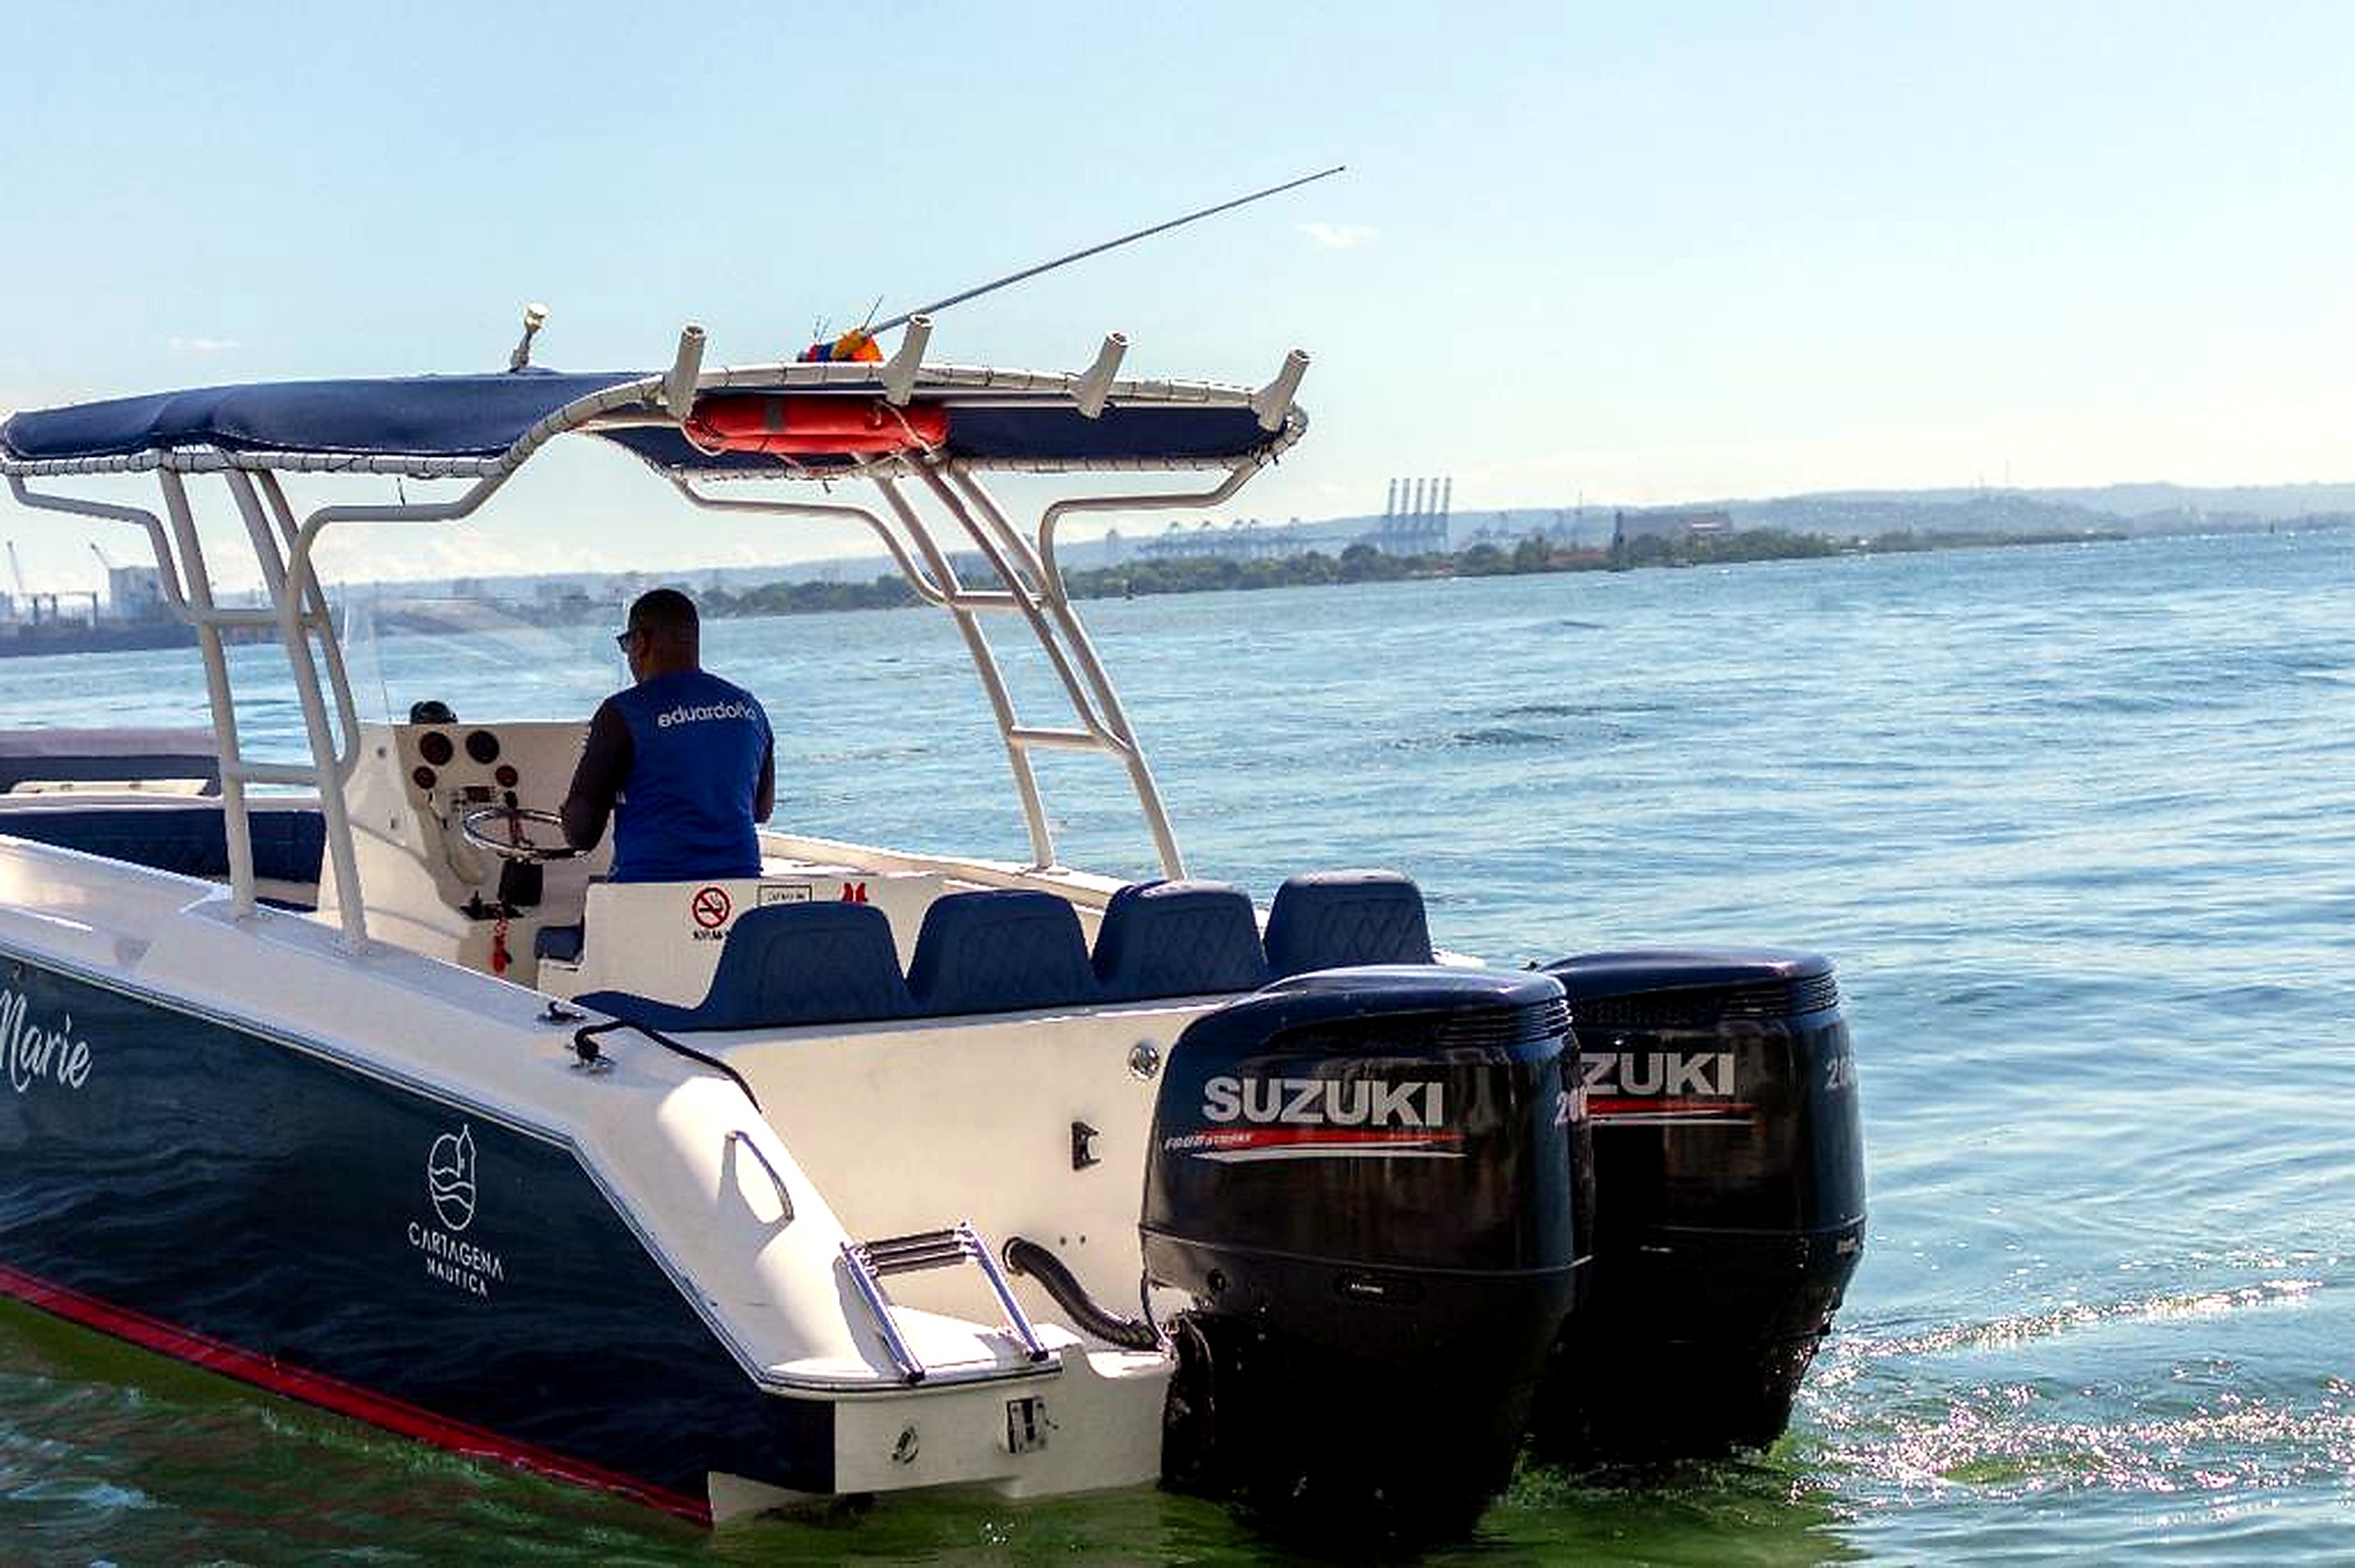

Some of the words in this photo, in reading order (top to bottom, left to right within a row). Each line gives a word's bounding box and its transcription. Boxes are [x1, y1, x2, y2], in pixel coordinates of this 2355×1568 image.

[1579, 1051, 1735, 1095] ZUKI
[1201, 1076, 1443, 1127] SUZUKI
[407, 1220, 505, 1282] CARTAGENA
